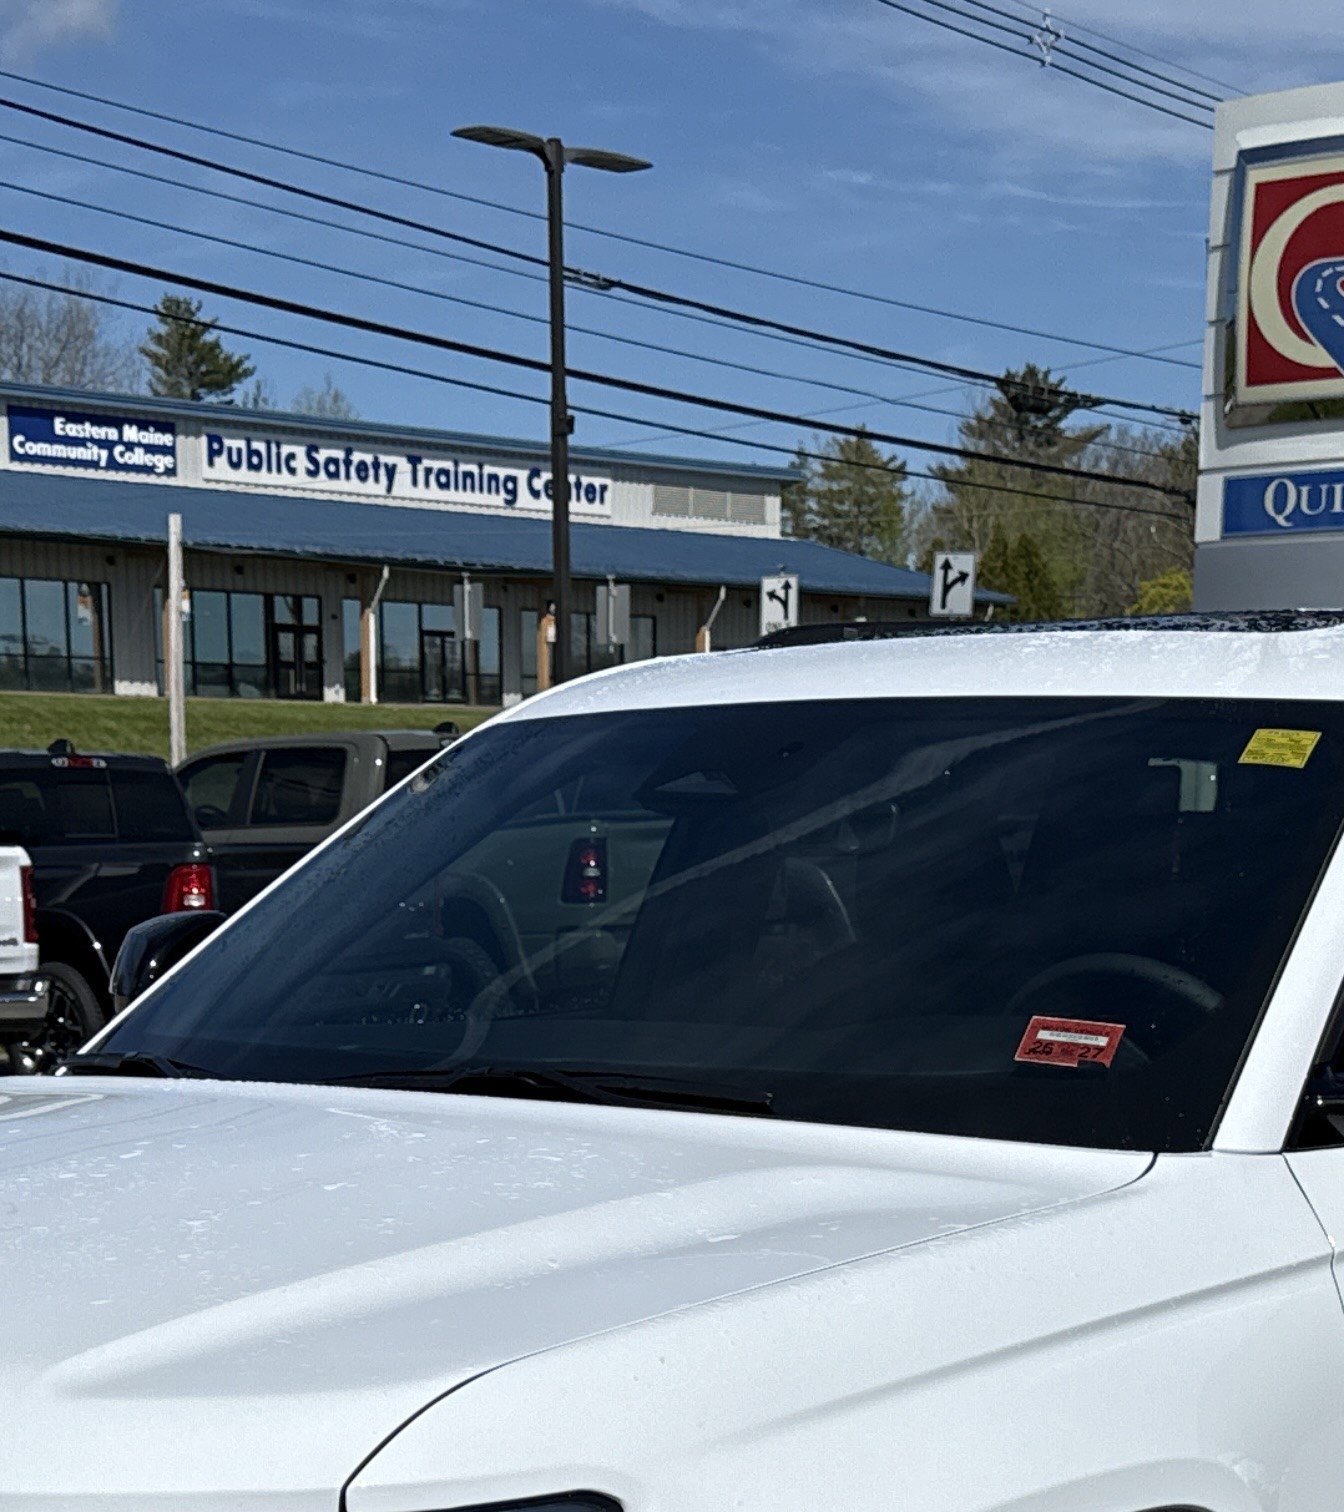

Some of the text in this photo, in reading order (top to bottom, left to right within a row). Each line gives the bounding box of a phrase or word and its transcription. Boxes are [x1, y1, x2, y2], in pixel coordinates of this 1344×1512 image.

[53, 416, 174, 446] Eastern Maine
[12, 435, 175, 473] Community College
[206, 434, 296, 476] Public
[304, 443, 397, 494] Safety
[407, 455, 518, 506] Training
